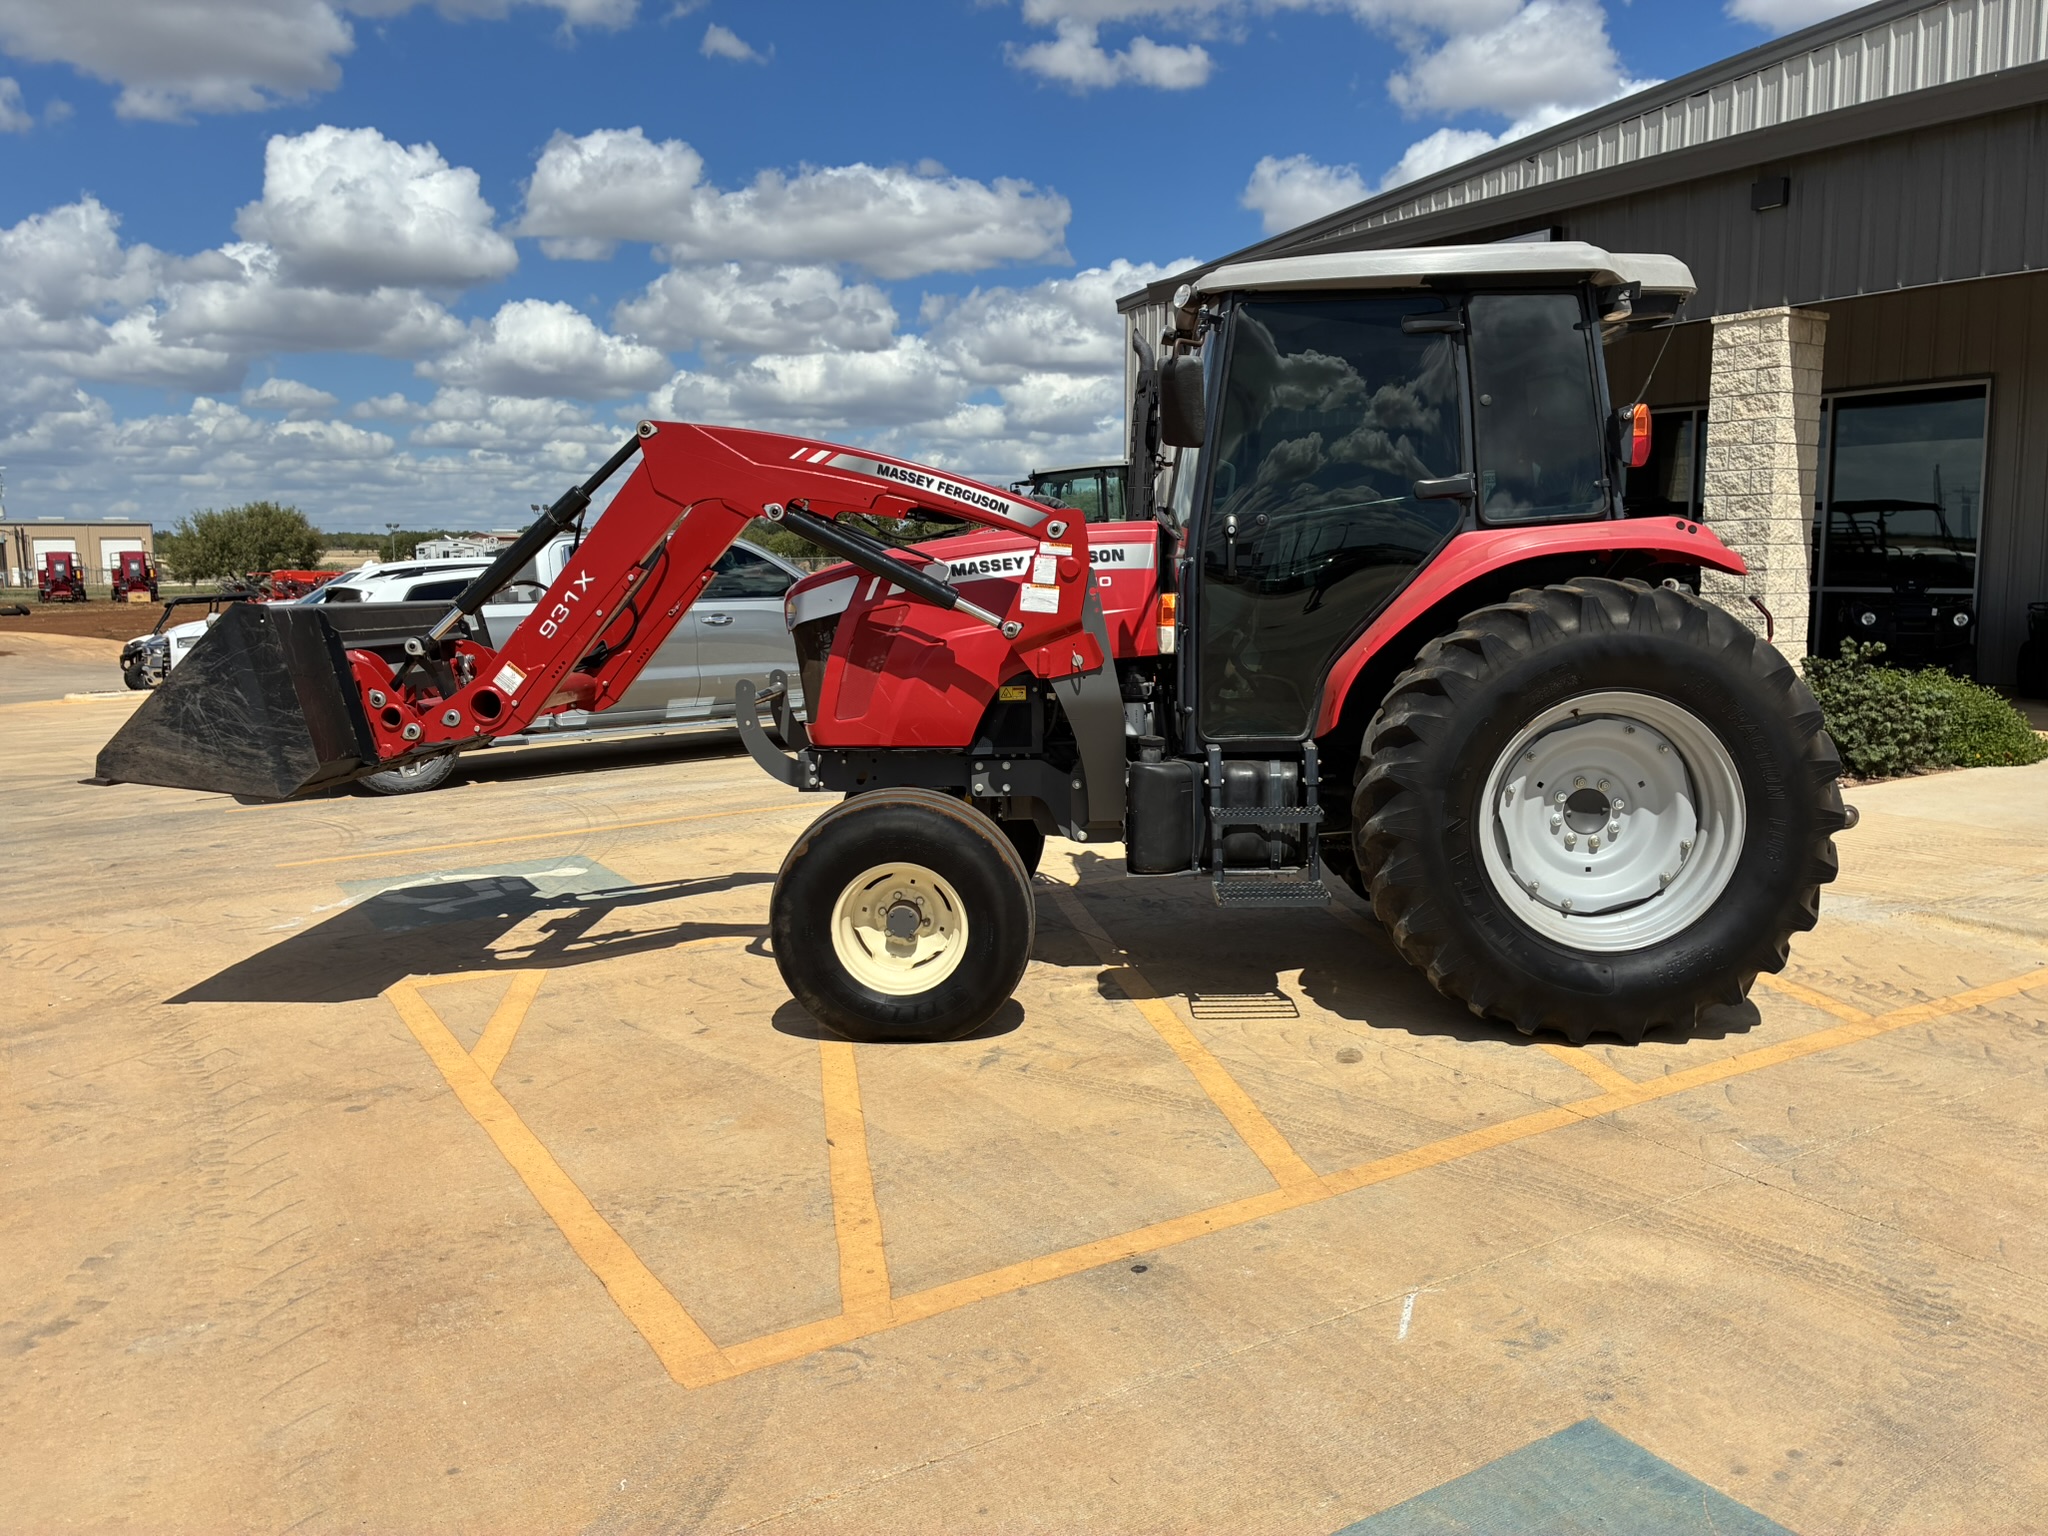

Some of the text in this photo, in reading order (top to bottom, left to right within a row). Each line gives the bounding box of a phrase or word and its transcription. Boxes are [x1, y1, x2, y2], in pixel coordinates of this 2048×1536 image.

[876, 463, 1010, 516] MASSEY FERGUSON
[951, 556, 1024, 577] MASSEY
[538, 569, 596, 639] 931X
